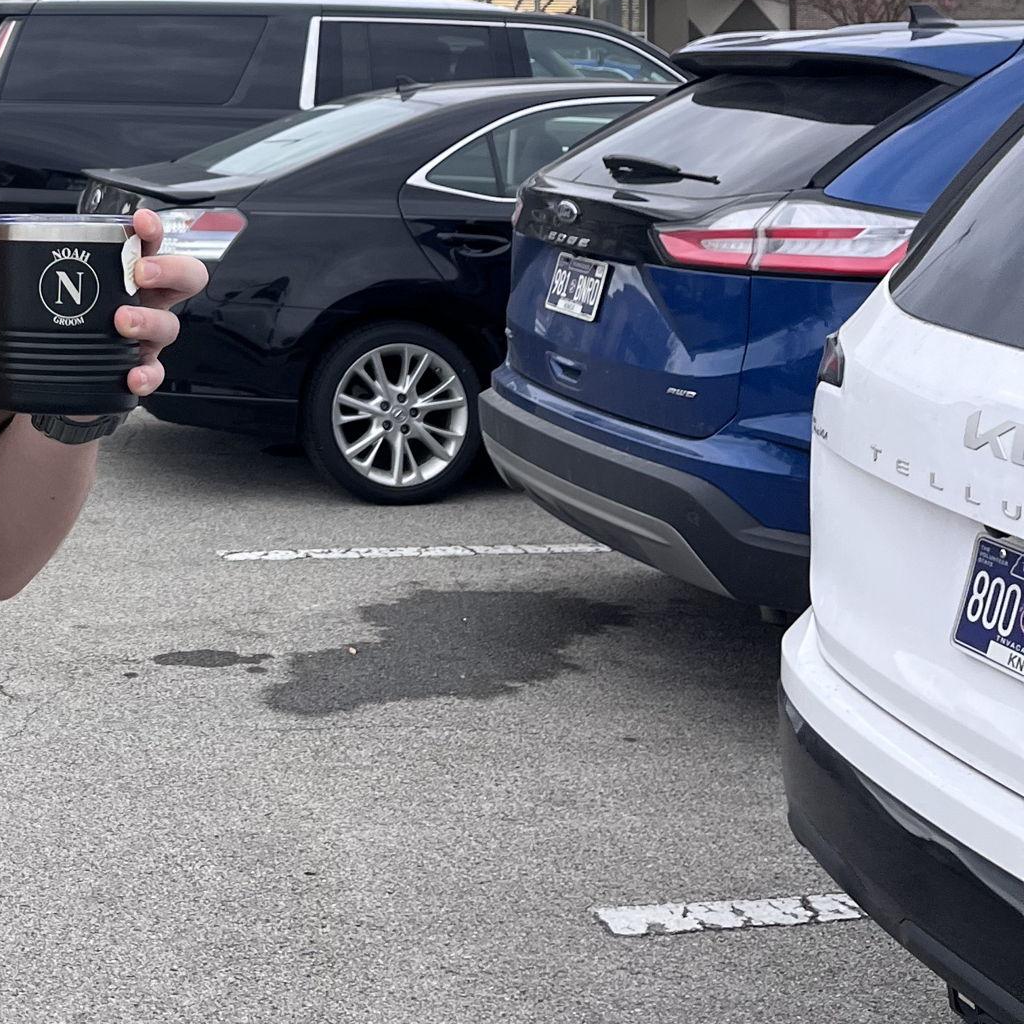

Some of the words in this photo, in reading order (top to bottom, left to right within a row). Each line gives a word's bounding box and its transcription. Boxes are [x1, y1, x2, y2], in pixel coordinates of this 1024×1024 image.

[51, 247, 91, 263] NOAH
[55, 270, 84, 305] N
[551, 268, 572, 297] 981
[53, 315, 85, 327] GROOM
[966, 570, 1022, 637] 800
[1007, 652, 1024, 672] KN
